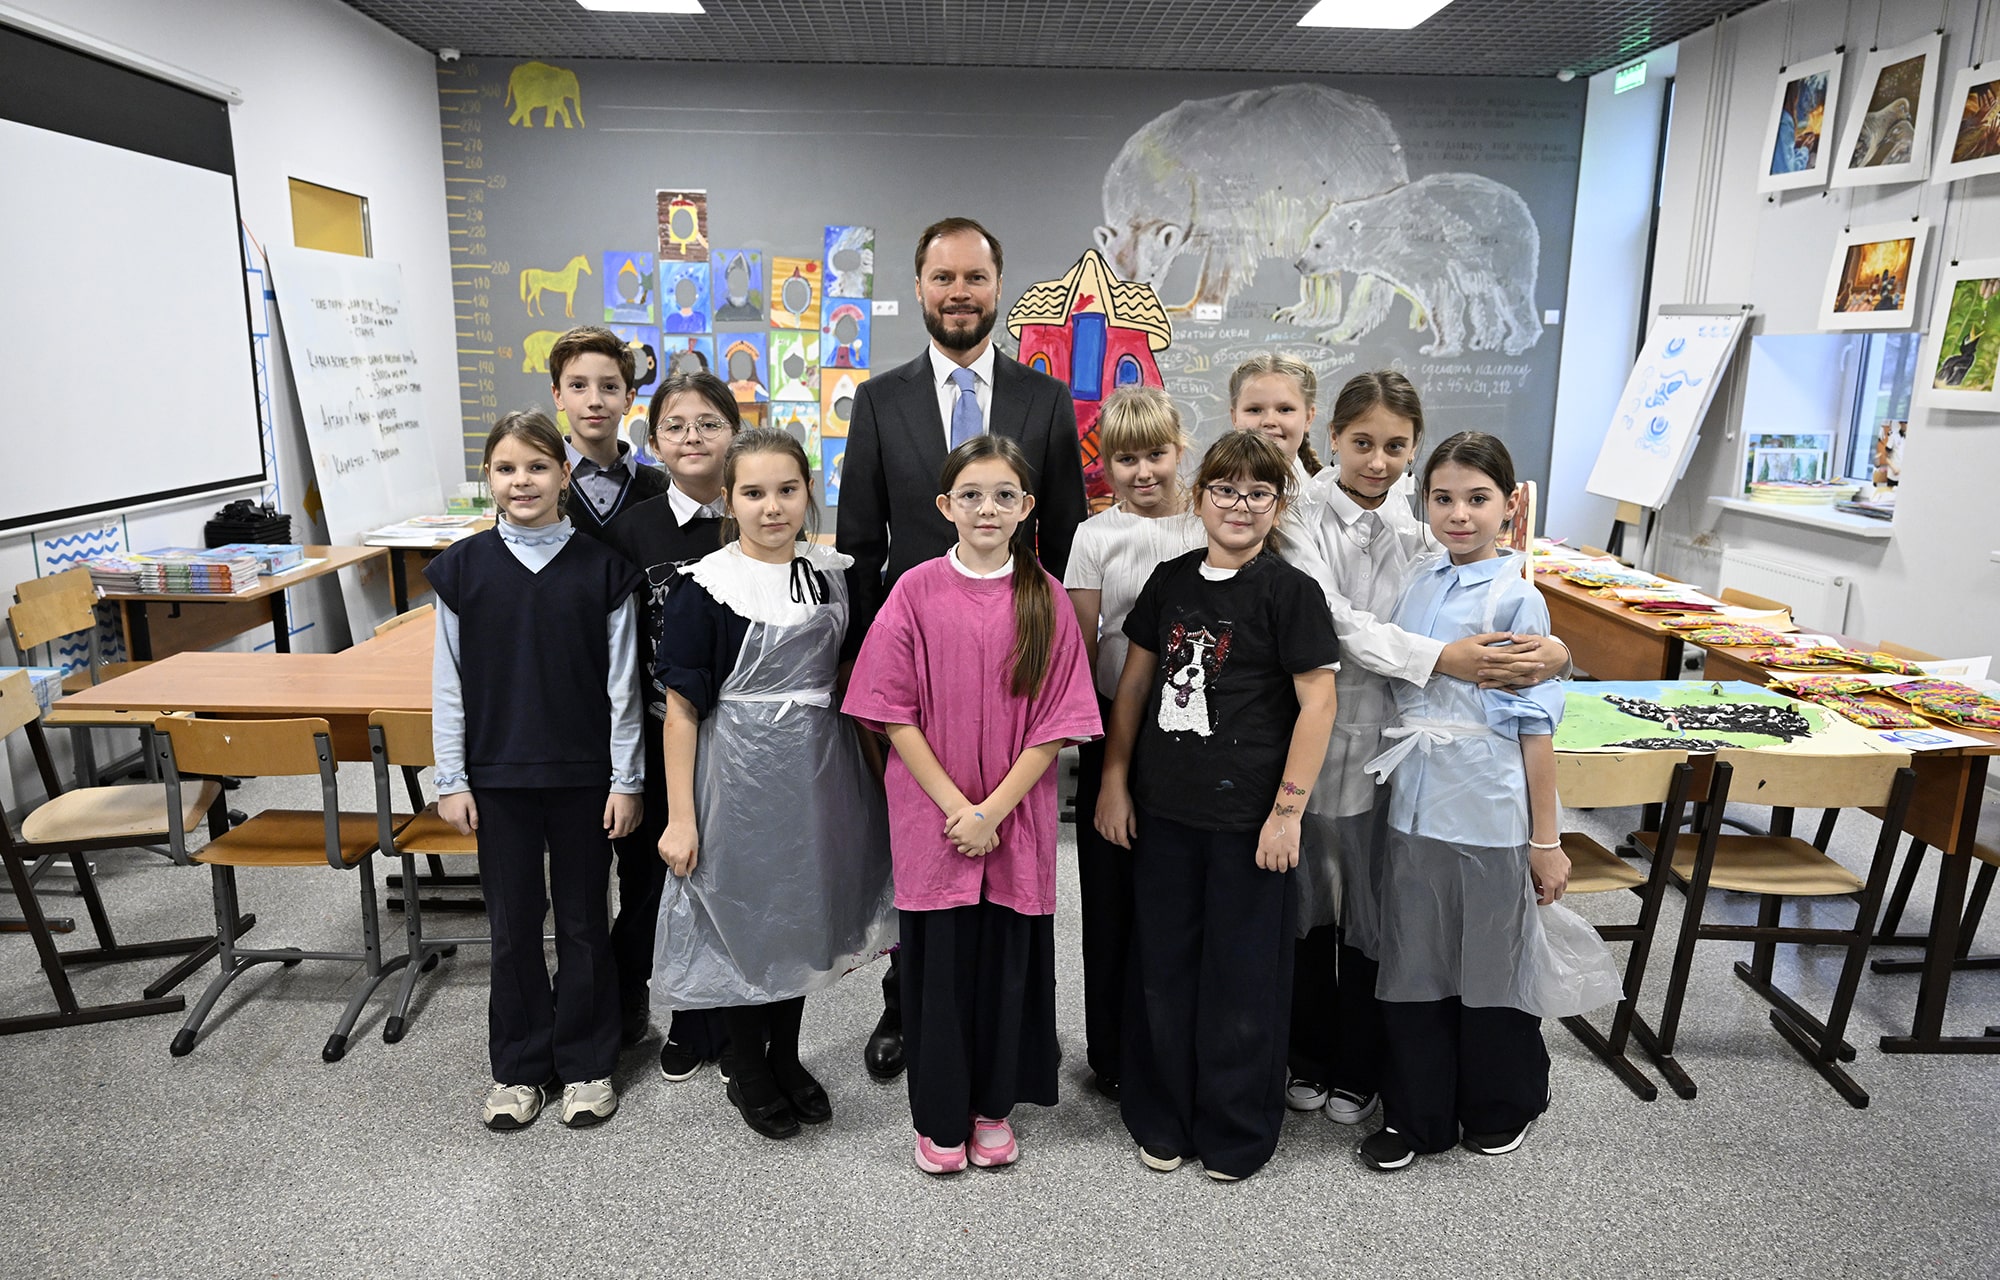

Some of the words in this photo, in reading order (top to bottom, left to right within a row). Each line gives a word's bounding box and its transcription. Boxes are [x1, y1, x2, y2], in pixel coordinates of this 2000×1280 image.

[464, 138, 483, 152] 270
[465, 156, 483, 169] 260
[487, 175, 507, 189] 250
[466, 209, 483, 221] 230
[468, 225, 486, 238] 220
[469, 242, 487, 255] 210
[491, 261, 510, 275] 200
[473, 277, 490, 290] 190
[473, 296, 489, 309] 180
[473, 312, 490, 325] 170
[476, 330, 493, 343] 160
[479, 363, 495, 375] 140
[479, 380, 495, 392] 130
[481, 410, 497, 423] 110
